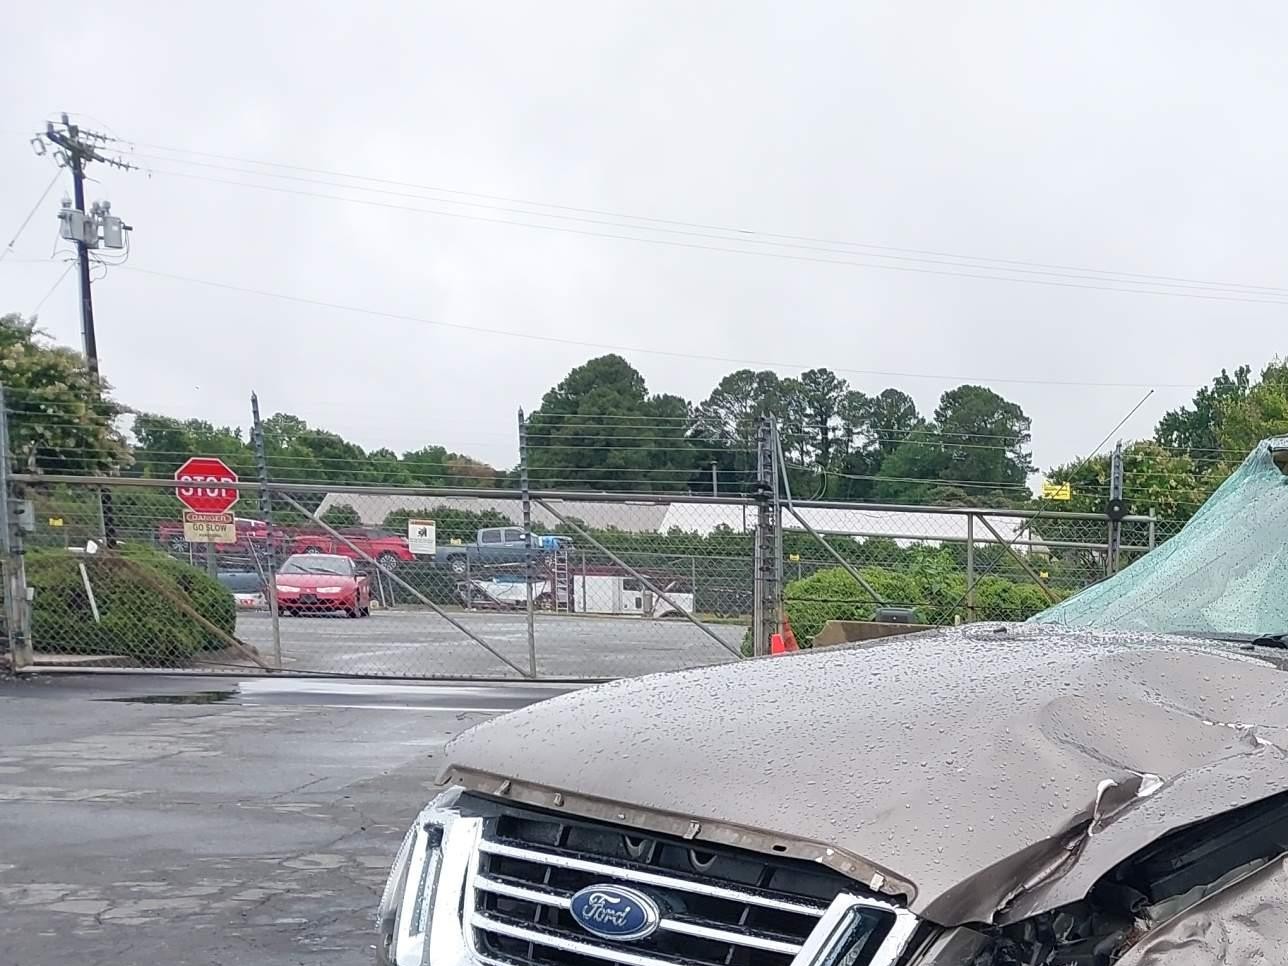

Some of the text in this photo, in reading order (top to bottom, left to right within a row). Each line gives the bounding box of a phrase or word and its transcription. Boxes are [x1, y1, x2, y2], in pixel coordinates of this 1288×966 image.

[180, 475, 233, 497] STOP
[193, 523, 227, 532] GO SLOW
[582, 892, 631, 927] Ford
